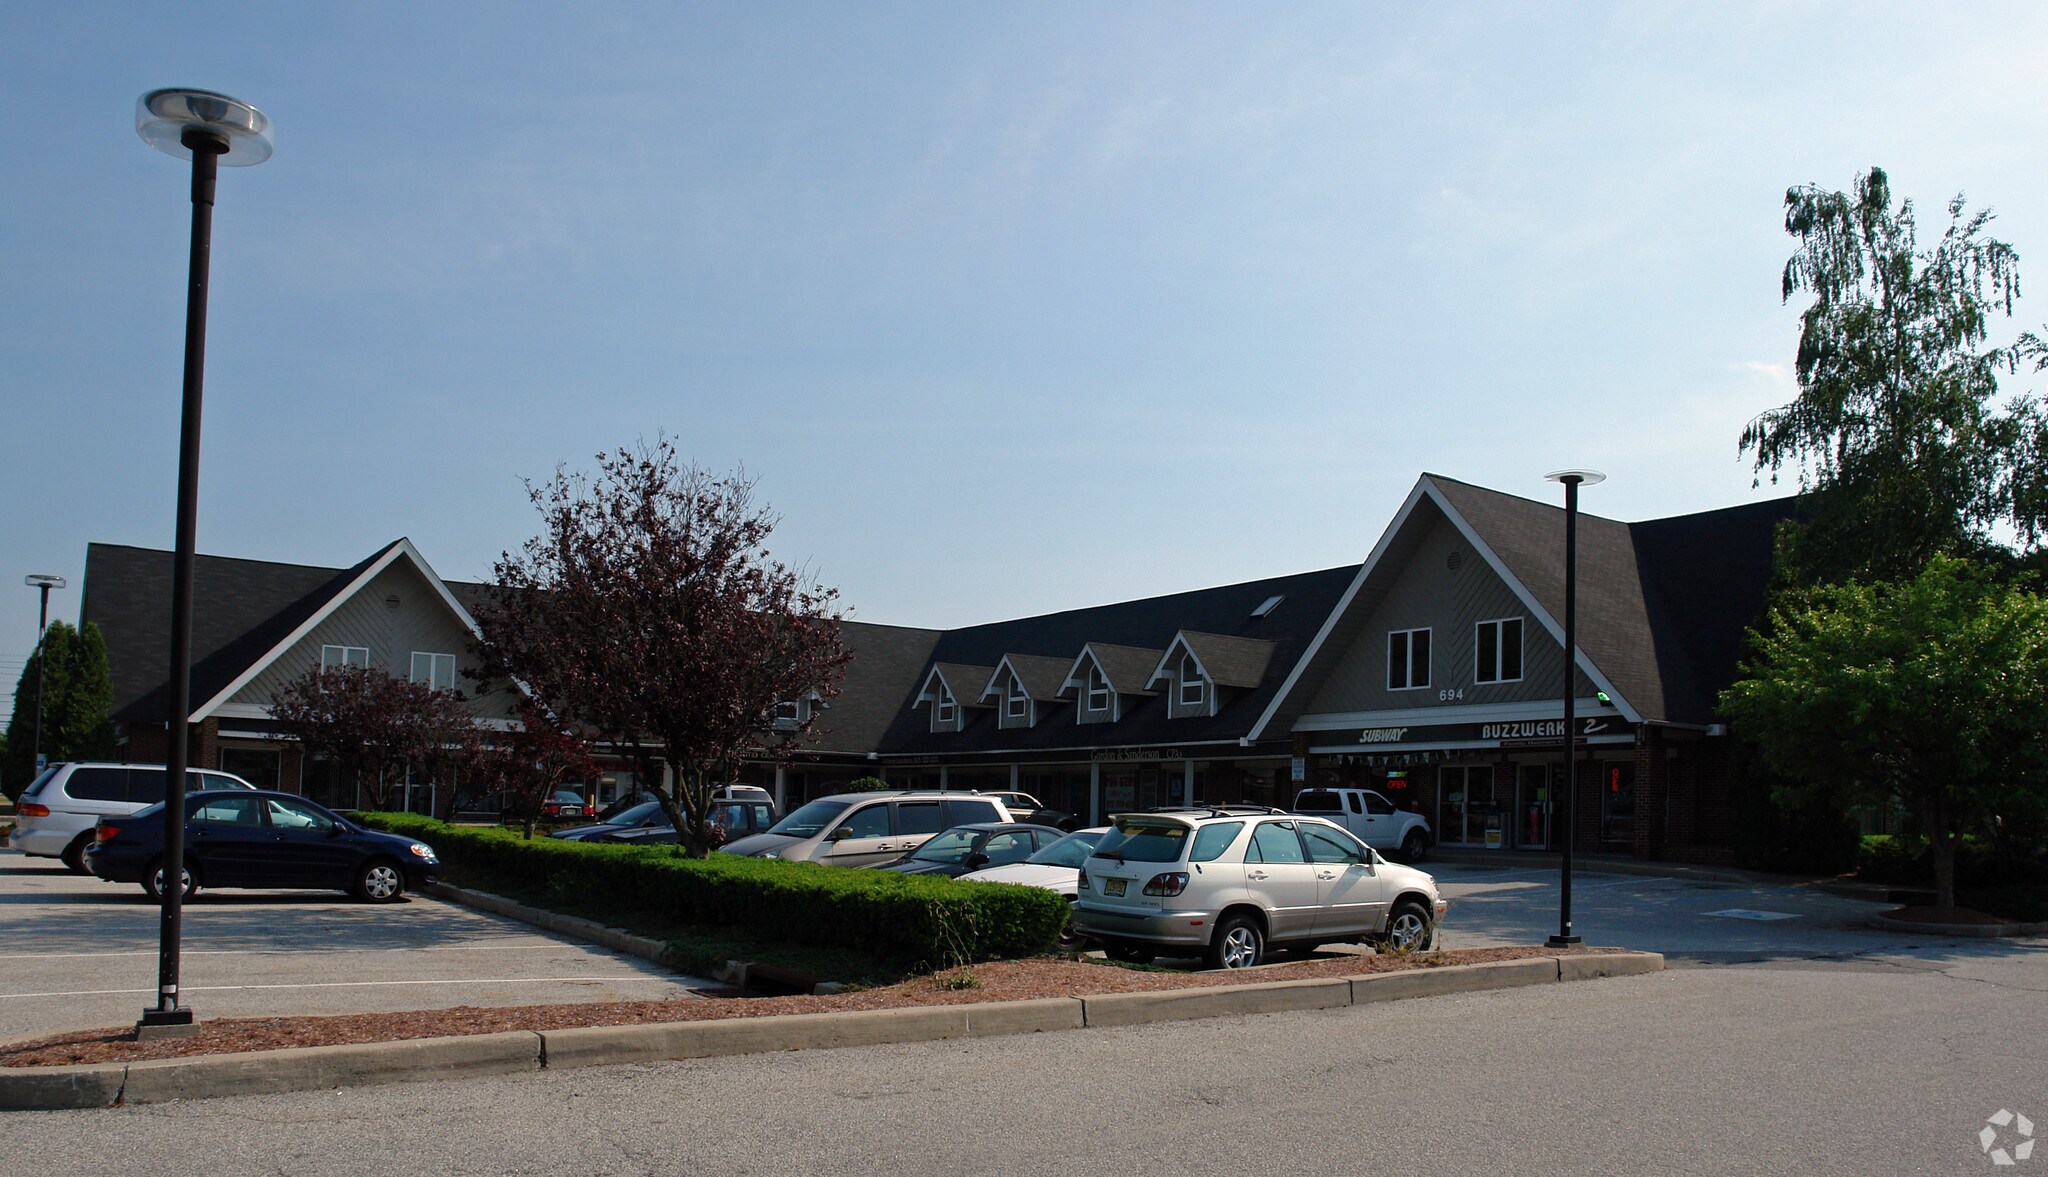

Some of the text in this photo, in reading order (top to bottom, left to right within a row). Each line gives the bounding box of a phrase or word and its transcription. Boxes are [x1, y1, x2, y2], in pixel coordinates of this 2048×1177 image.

[1439, 689, 1464, 701] 694
[1583, 718, 1609, 734] 2
[1359, 728, 1408, 743] SUBWAY
[1387, 780, 1407, 789] OPEN
